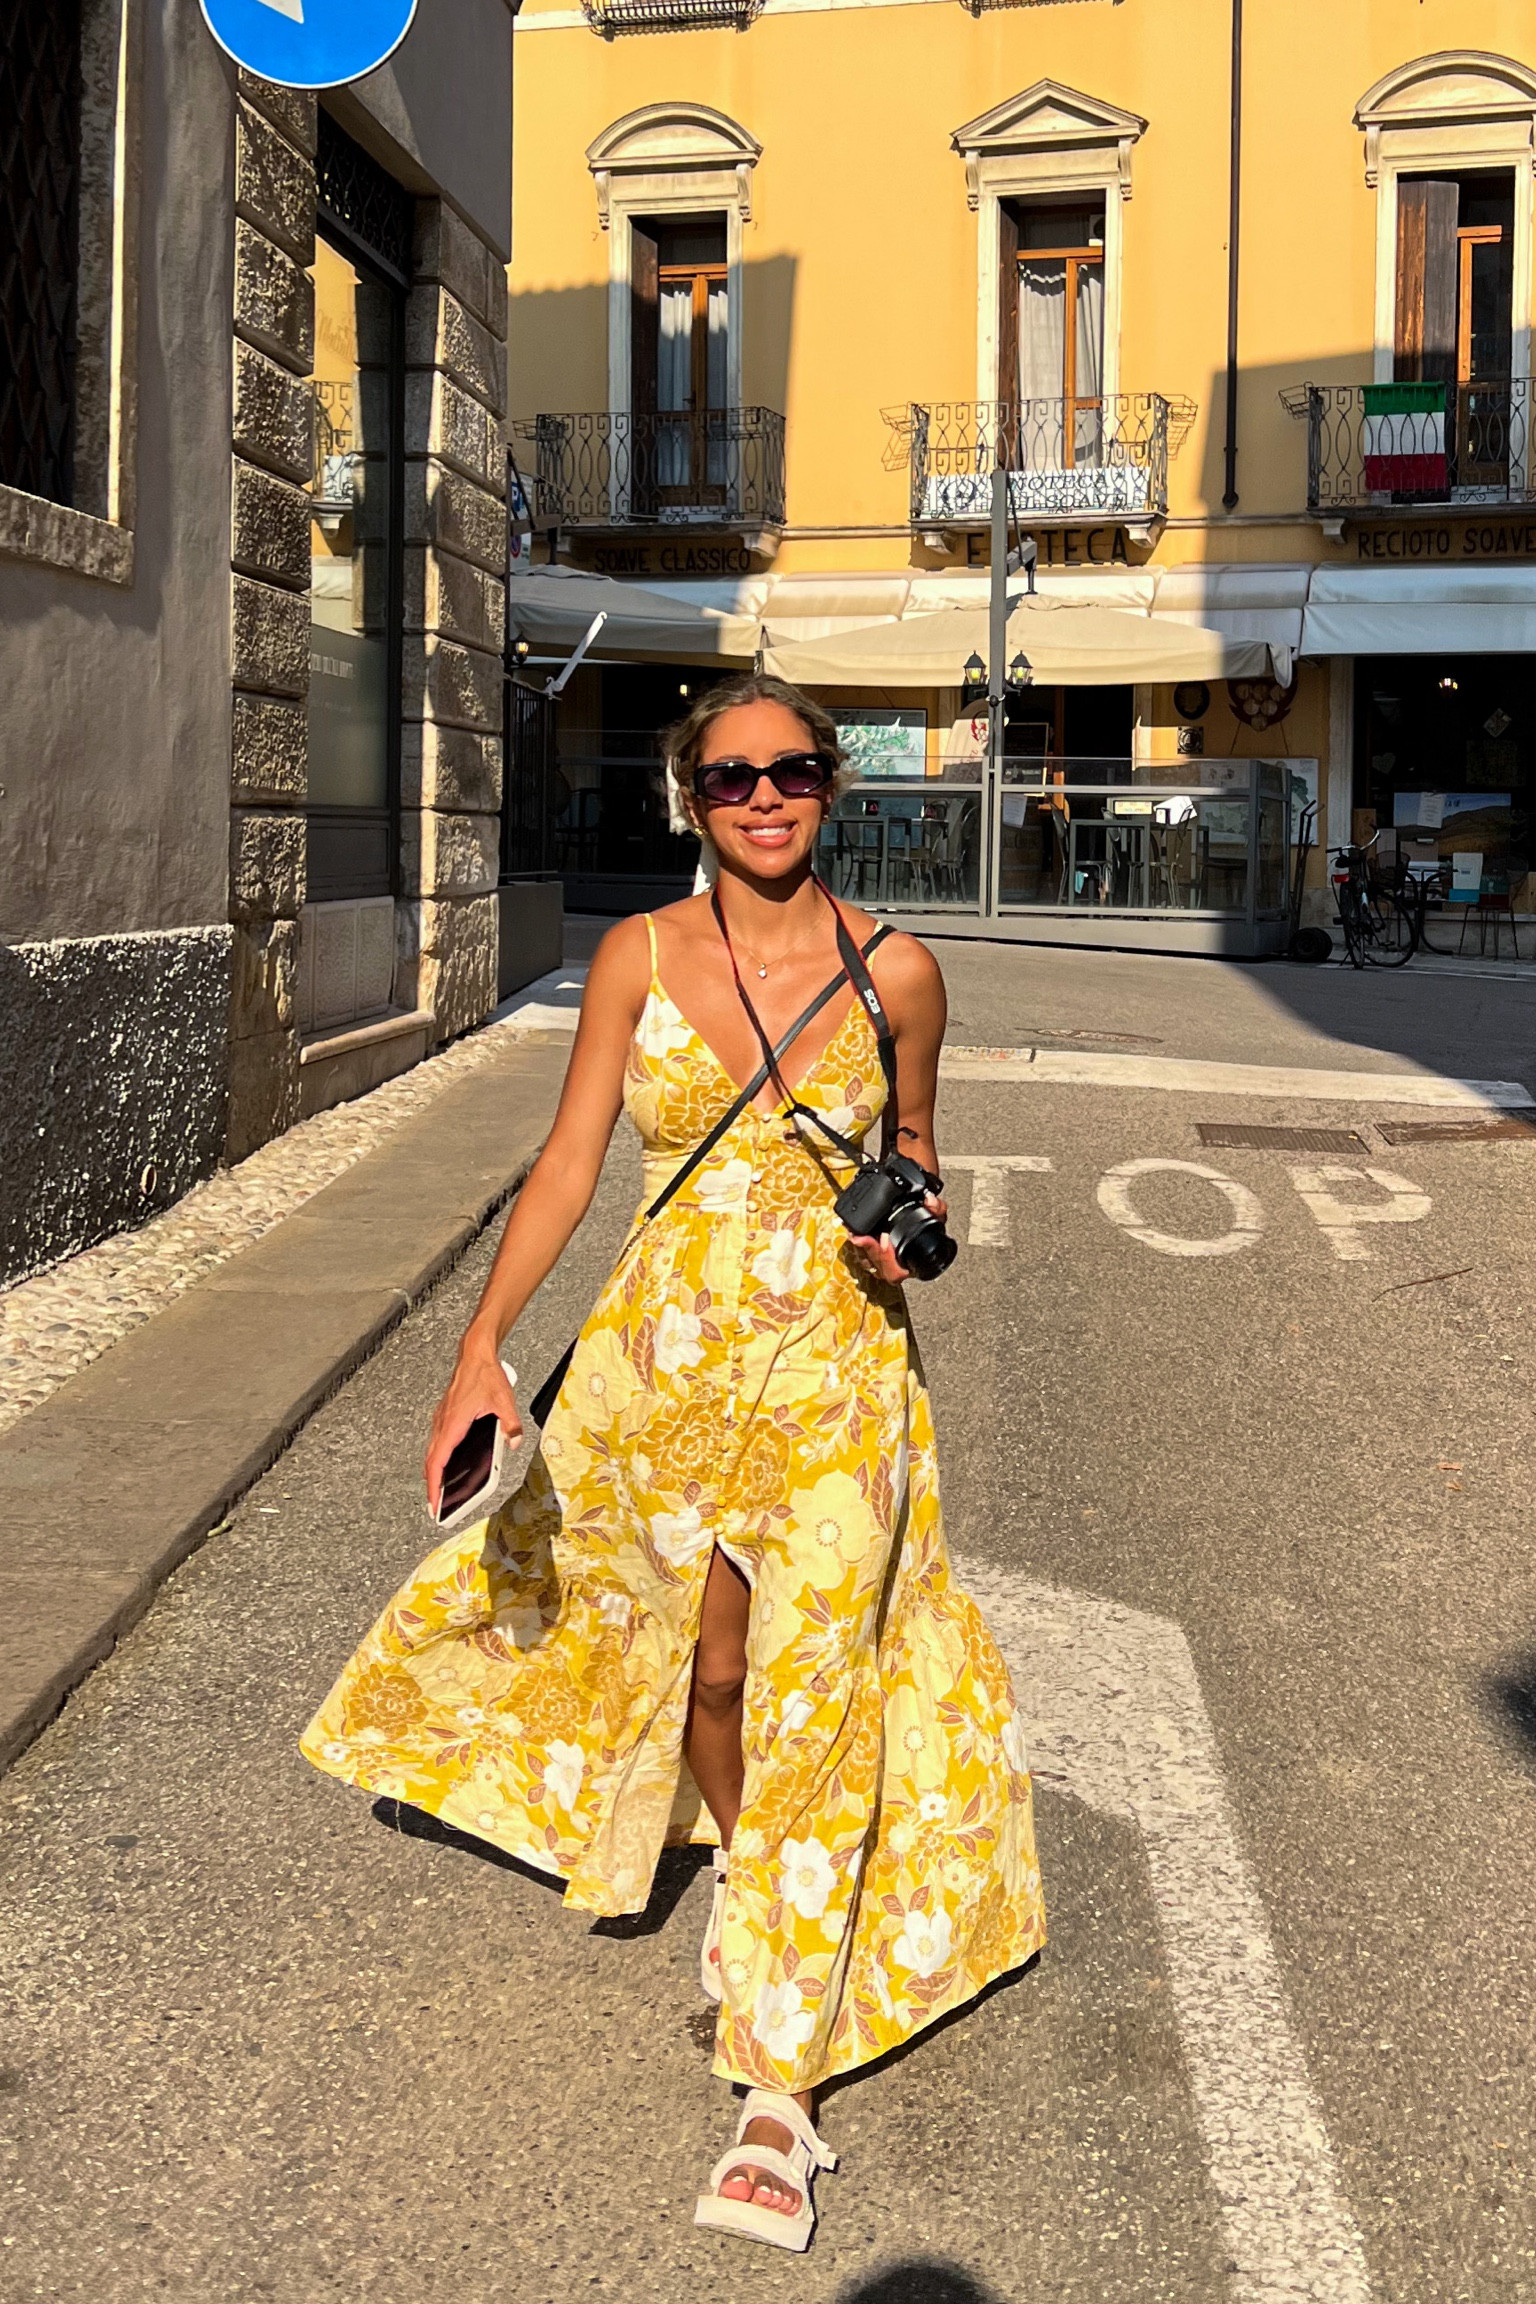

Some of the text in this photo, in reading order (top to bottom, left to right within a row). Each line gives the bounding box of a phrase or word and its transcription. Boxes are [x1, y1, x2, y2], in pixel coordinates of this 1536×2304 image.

[1009, 474, 1109, 491] NOTECA
[967, 528, 1128, 568] ETECA
[1358, 526, 1536, 558] RECIOTO SOAVE
[595, 548, 749, 572] SOAVE CLASSICO
[863, 988, 881, 1015] EOS
[938, 1155, 1433, 1260] TOP
